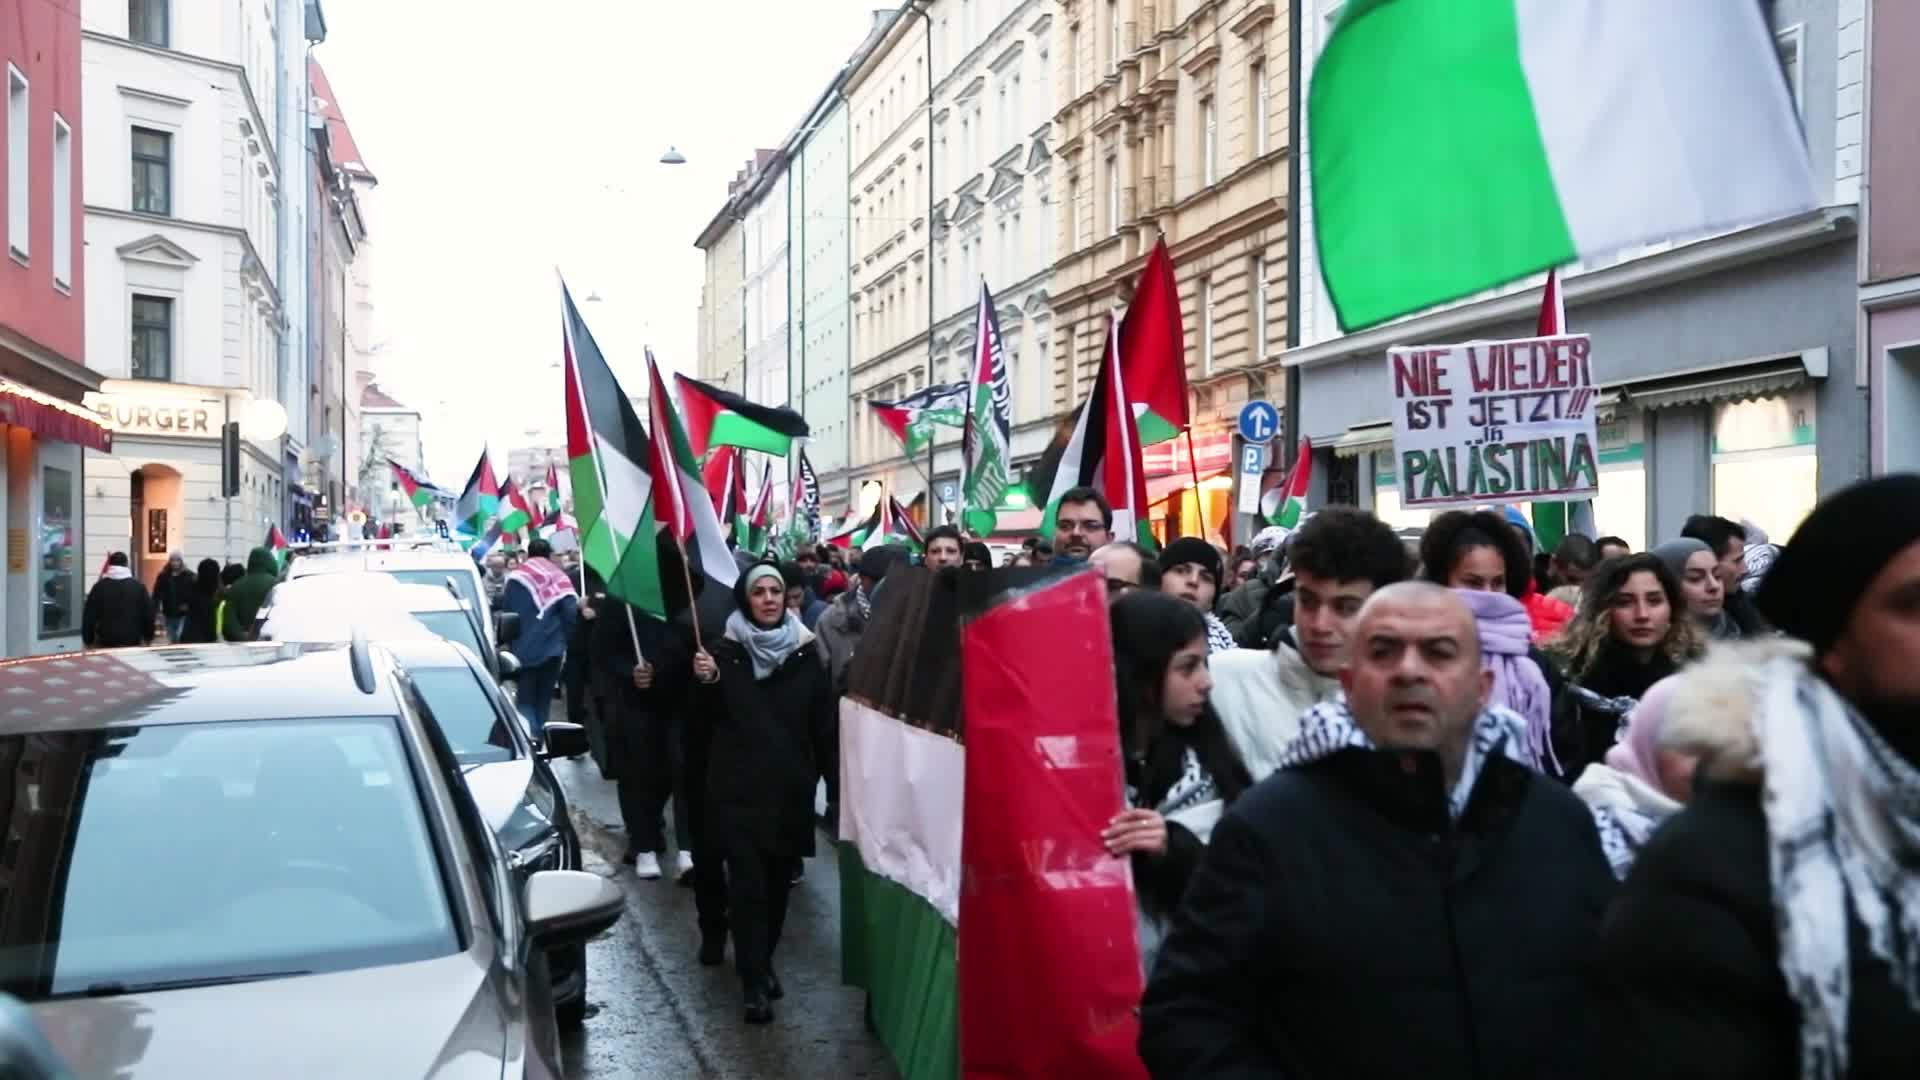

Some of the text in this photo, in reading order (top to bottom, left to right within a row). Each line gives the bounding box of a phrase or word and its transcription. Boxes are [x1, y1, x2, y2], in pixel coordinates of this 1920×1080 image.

[1393, 337, 1591, 397] NIE WIEDER
[97, 402, 208, 432] BURGER
[1406, 398, 1453, 430] IST
[1245, 448, 1258, 470] P
[1402, 432, 1598, 499] PALÄSTINA
